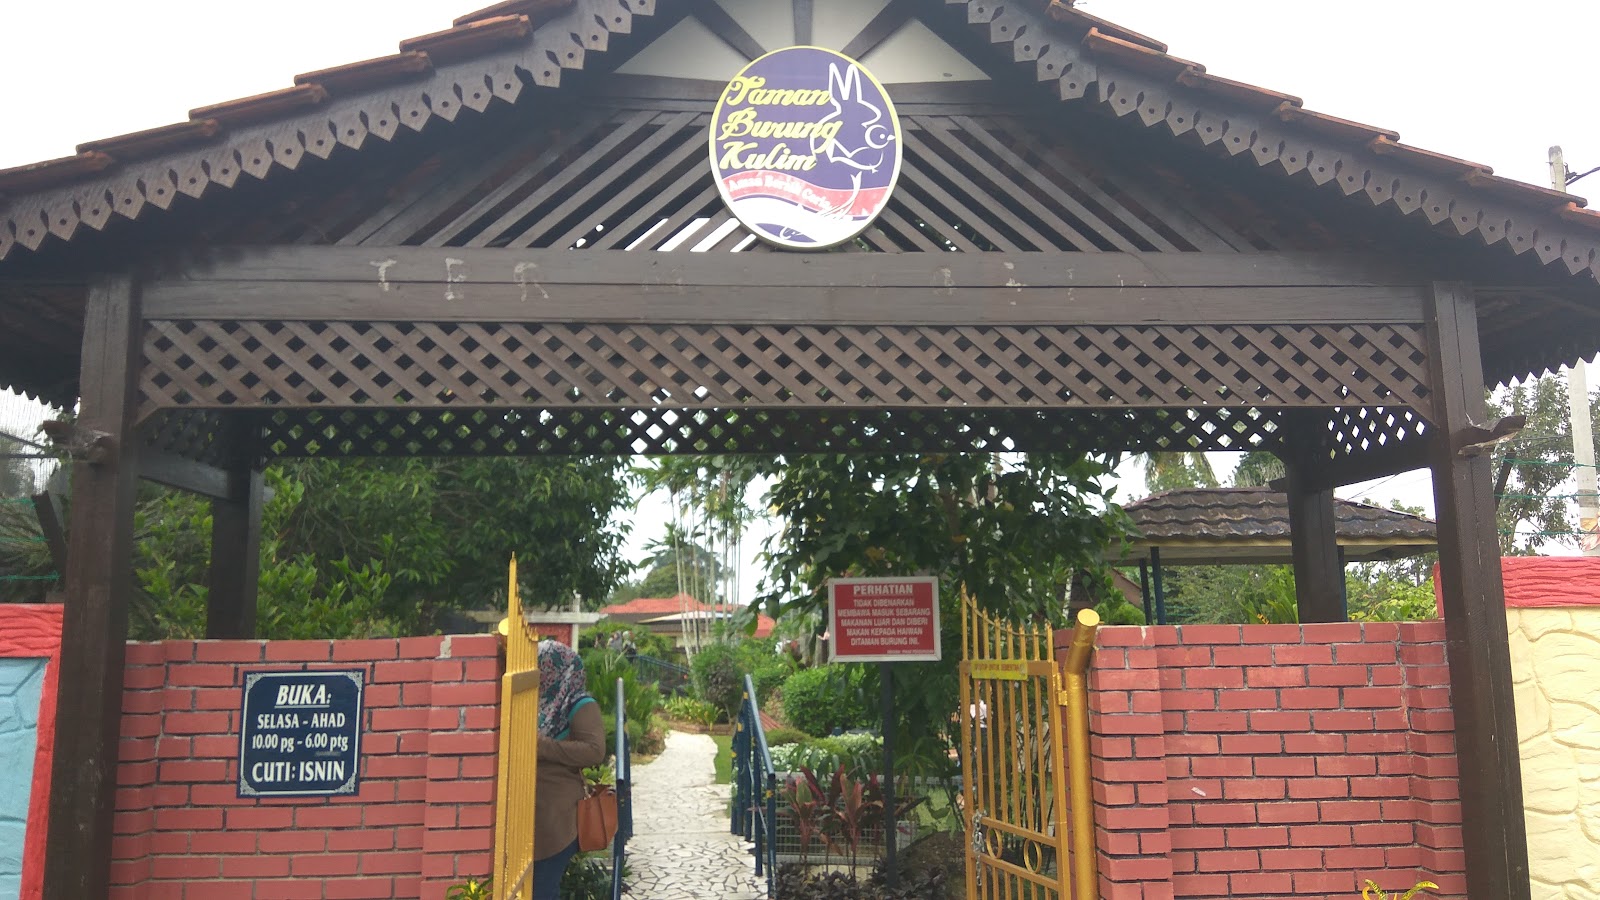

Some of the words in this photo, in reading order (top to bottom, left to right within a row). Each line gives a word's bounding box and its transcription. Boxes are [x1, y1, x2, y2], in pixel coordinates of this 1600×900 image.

[726, 75, 831, 106] Taman
[716, 107, 843, 154] Burung
[719, 141, 817, 170] Kulim
[853, 584, 914, 596] PERHATIAN
[853, 599, 873, 608] TIDAK
[873, 598, 915, 607] DIBENARKAN
[837, 609, 871, 617] MEMBAWA
[872, 608, 895, 616] MASUK
[895, 608, 931, 616] SEBARANG
[841, 619, 873, 627] MAKANAN
[873, 618, 891, 626] LUAR
[891, 618, 906, 626] DAN
[906, 617, 928, 625] DIBERI
[846, 628, 870, 636] MAKAN
[870, 628, 897, 636] KEPADA
[896, 627, 923, 635] HAIWAN
[850, 638, 880, 646] DITAMAN
[880, 637, 908, 645] BURUNG
[275, 684, 332, 706] BUKA:
[257, 713, 300, 729] SELASA
[311, 712, 346, 728] AHAD
[252, 733, 279, 749] 10.00
[280, 737, 295, 753] pg
[305, 733, 328, 749] 6.00
[329, 734, 349, 752] ptg
[251, 761, 296, 782] CUTI:
[299, 760, 345, 782] ISNIN
